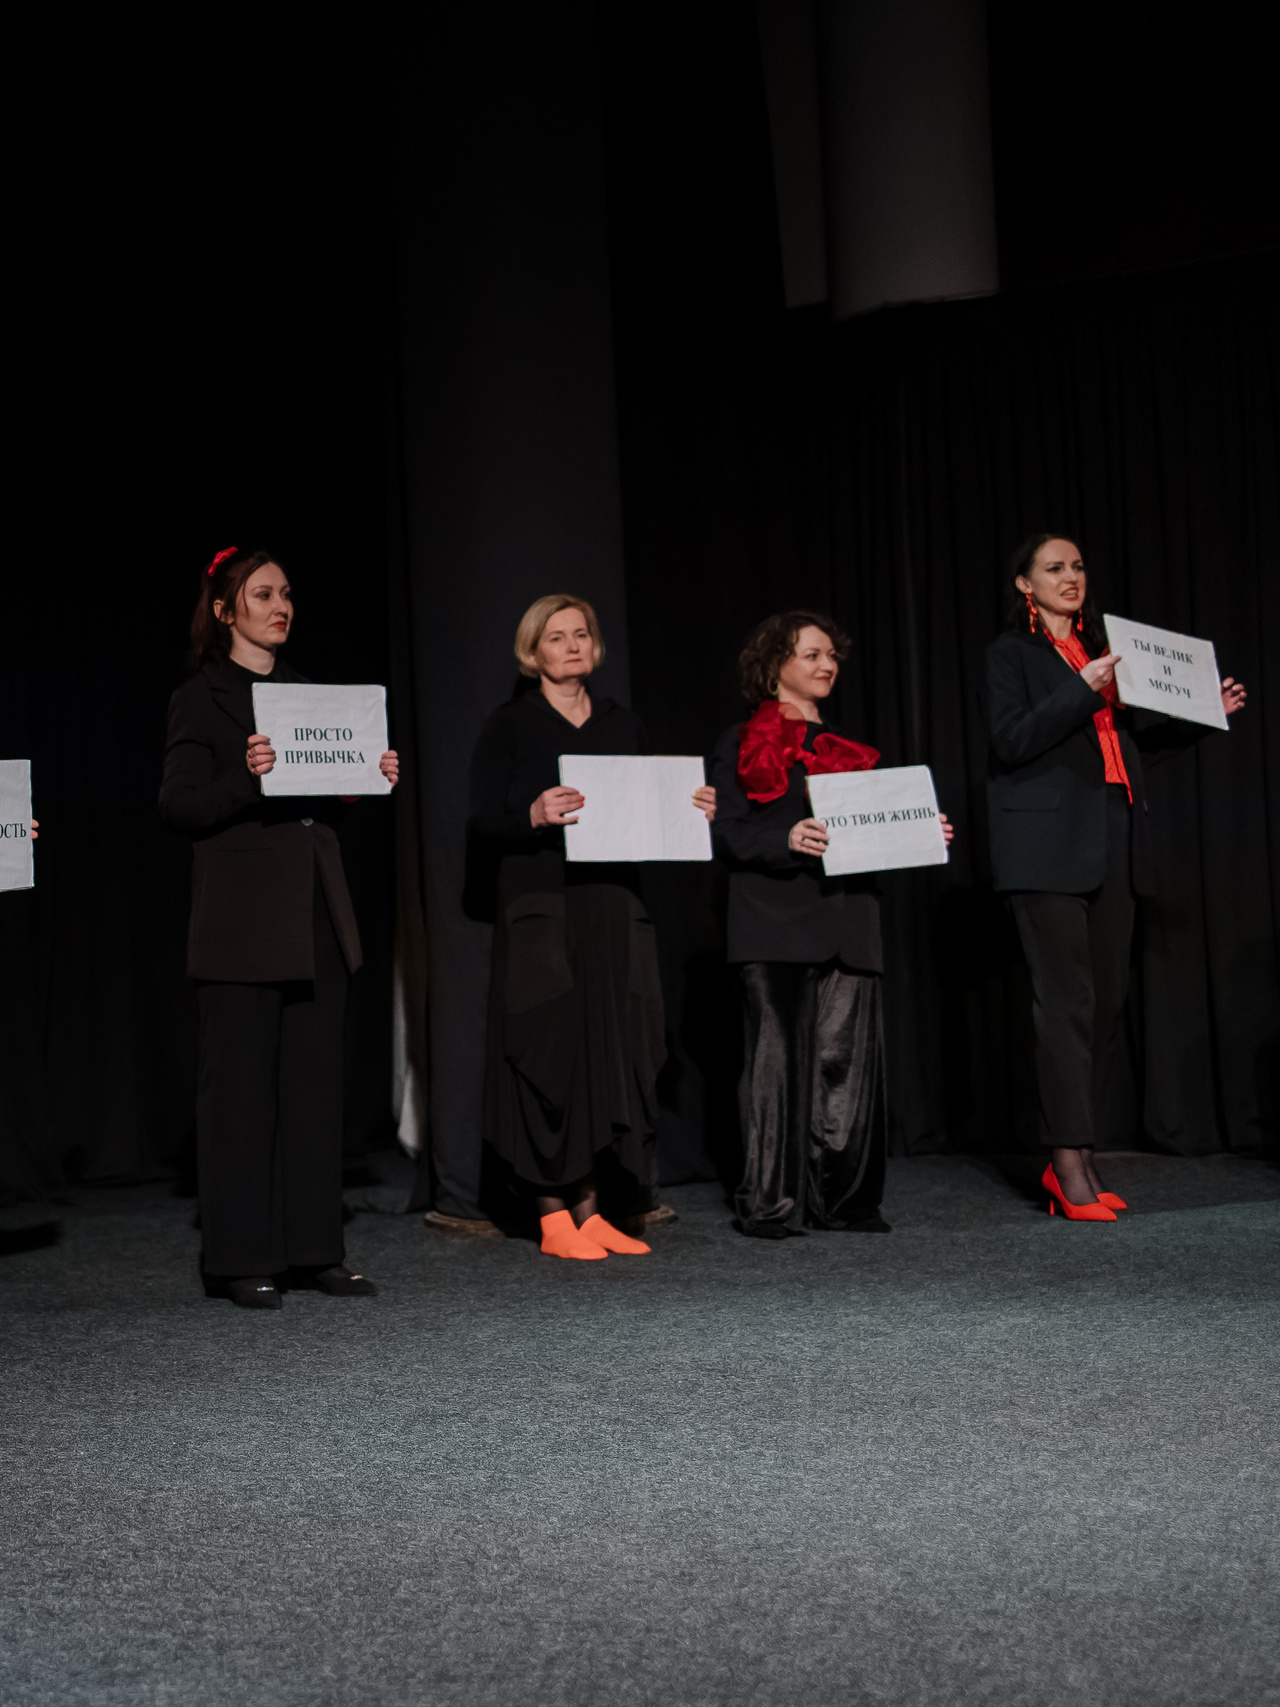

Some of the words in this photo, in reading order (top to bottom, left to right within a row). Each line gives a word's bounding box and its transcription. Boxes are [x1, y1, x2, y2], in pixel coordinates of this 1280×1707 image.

[1132, 638, 1151, 652] ТЫ
[1153, 645, 1194, 665] ВЕЛИК
[1163, 665, 1172, 676] И
[1149, 678, 1191, 699] МОГУЧ
[294, 727, 353, 741] ПРОСТО
[285, 750, 365, 764] ПРИВЫЧКА
[850, 810, 886, 827] ТВОЯ
[888, 807, 936, 822] ЖИЗНЬ
